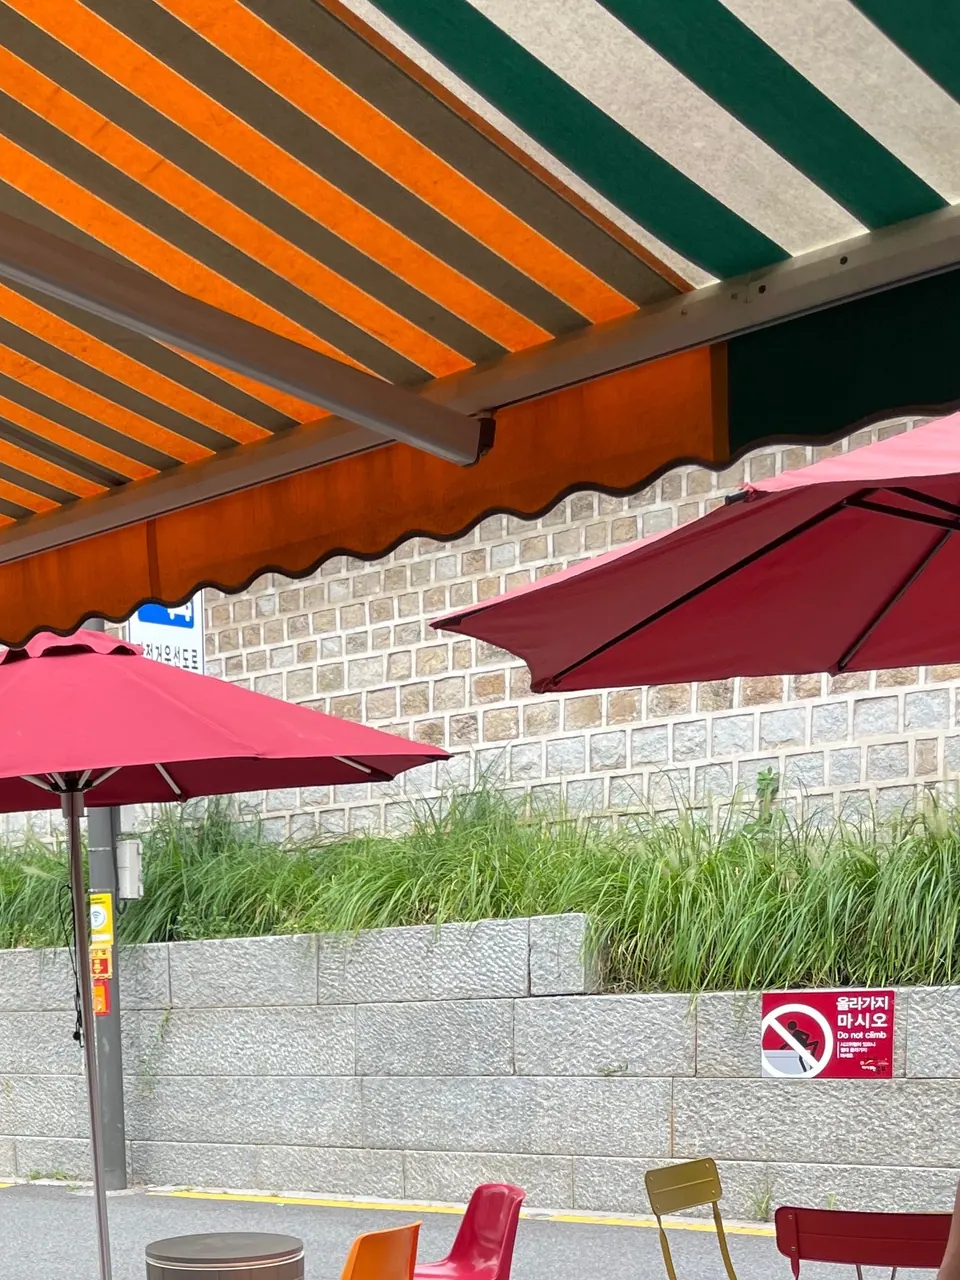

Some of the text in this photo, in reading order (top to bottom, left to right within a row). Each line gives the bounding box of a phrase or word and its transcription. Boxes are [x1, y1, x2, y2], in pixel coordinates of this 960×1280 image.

[836, 996, 889, 1011] 올라가지
[837, 1012, 888, 1029] 마시오
[837, 1031, 887, 1039] Do not climb
